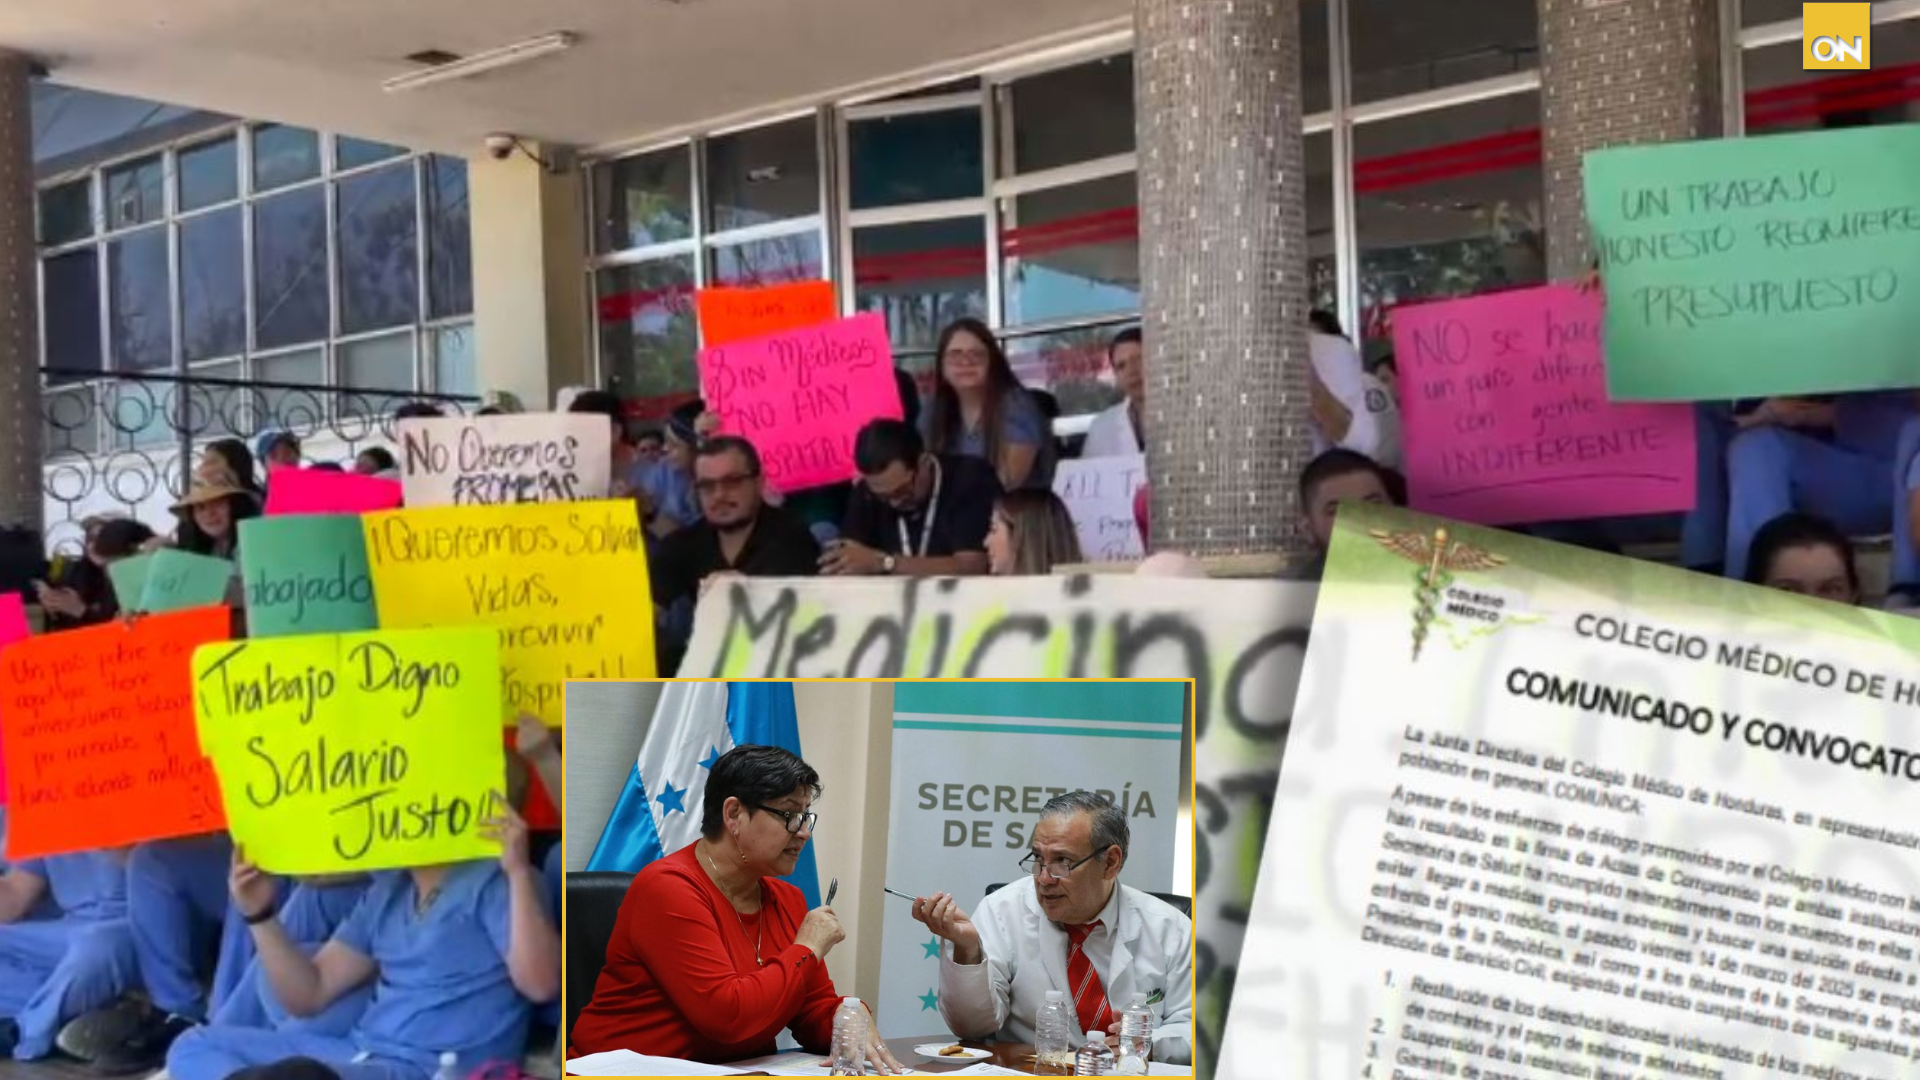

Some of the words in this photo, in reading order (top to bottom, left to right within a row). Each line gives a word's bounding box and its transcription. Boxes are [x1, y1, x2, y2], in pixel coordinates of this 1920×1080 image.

[1622, 187, 1669, 221] UN
[1680, 170, 1836, 213] TRABAJO
[1600, 224, 1736, 272] HONESTO
[1755, 206, 1920, 249] REQUIERE
[1632, 266, 1898, 328] PRESUPUESTO
[1412, 319, 1470, 367] NO
[736, 401, 776, 436] NO
[791, 384, 851, 424] HAY
[1424, 378, 1454, 400] un
[1453, 412, 1495, 434] con
[405, 428, 448, 476] No
[458, 426, 579, 473] Queremos
[1441, 425, 1662, 476] INDIFERENTE
[498, 614, 604, 649] revivir
[348, 640, 460, 719] Digno
[1574, 612, 1709, 661] COLEGIO
[1716, 641, 1838, 689] MÉDICO
[1844, 668, 1886, 699] DE
[1892, 679, 1920, 706] H
[1505, 666, 1715, 736] COMUNICADO
[1720, 711, 1742, 742] Y
[246, 736, 409, 808] Salario
[1403, 724, 1425, 744] La
[1475, 739, 1538, 768] Directiva
[1542, 756, 1566, 773] del
[1571, 760, 1626, 789] Colegio
[1632, 773, 1685, 799] Médico
[1689, 787, 1709, 804] de
[1793, 812, 1813, 826] en
[1470, 767, 1491, 782] en
[943, 820, 993, 848] DE
[1448, 800, 1469, 815] de
[1470, 804, 1492, 820] los
[1566, 824, 1586, 840] de
[1752, 866, 1767, 879] el
[1768, 864, 1824, 893] Colegio
[1826, 877, 1878, 903] Médico
[1458, 851, 1479, 867] de
[1575, 851, 1595, 867] de
[1645, 866, 1666, 883] de
[1430, 942, 1450, 959] de
[1791, 1020, 1811, 1036] de
[1448, 922, 1468, 940] de
[1750, 987, 1770, 1005] de
[1874, 1014, 1894, 1032] de
[1718, 956, 1739, 974] de
[1405, 1002, 1426, 1019] de
[1563, 1036, 1584, 1052] de
[1491, 995, 1512, 1013] de
[1486, 1044, 1507, 1061] de
